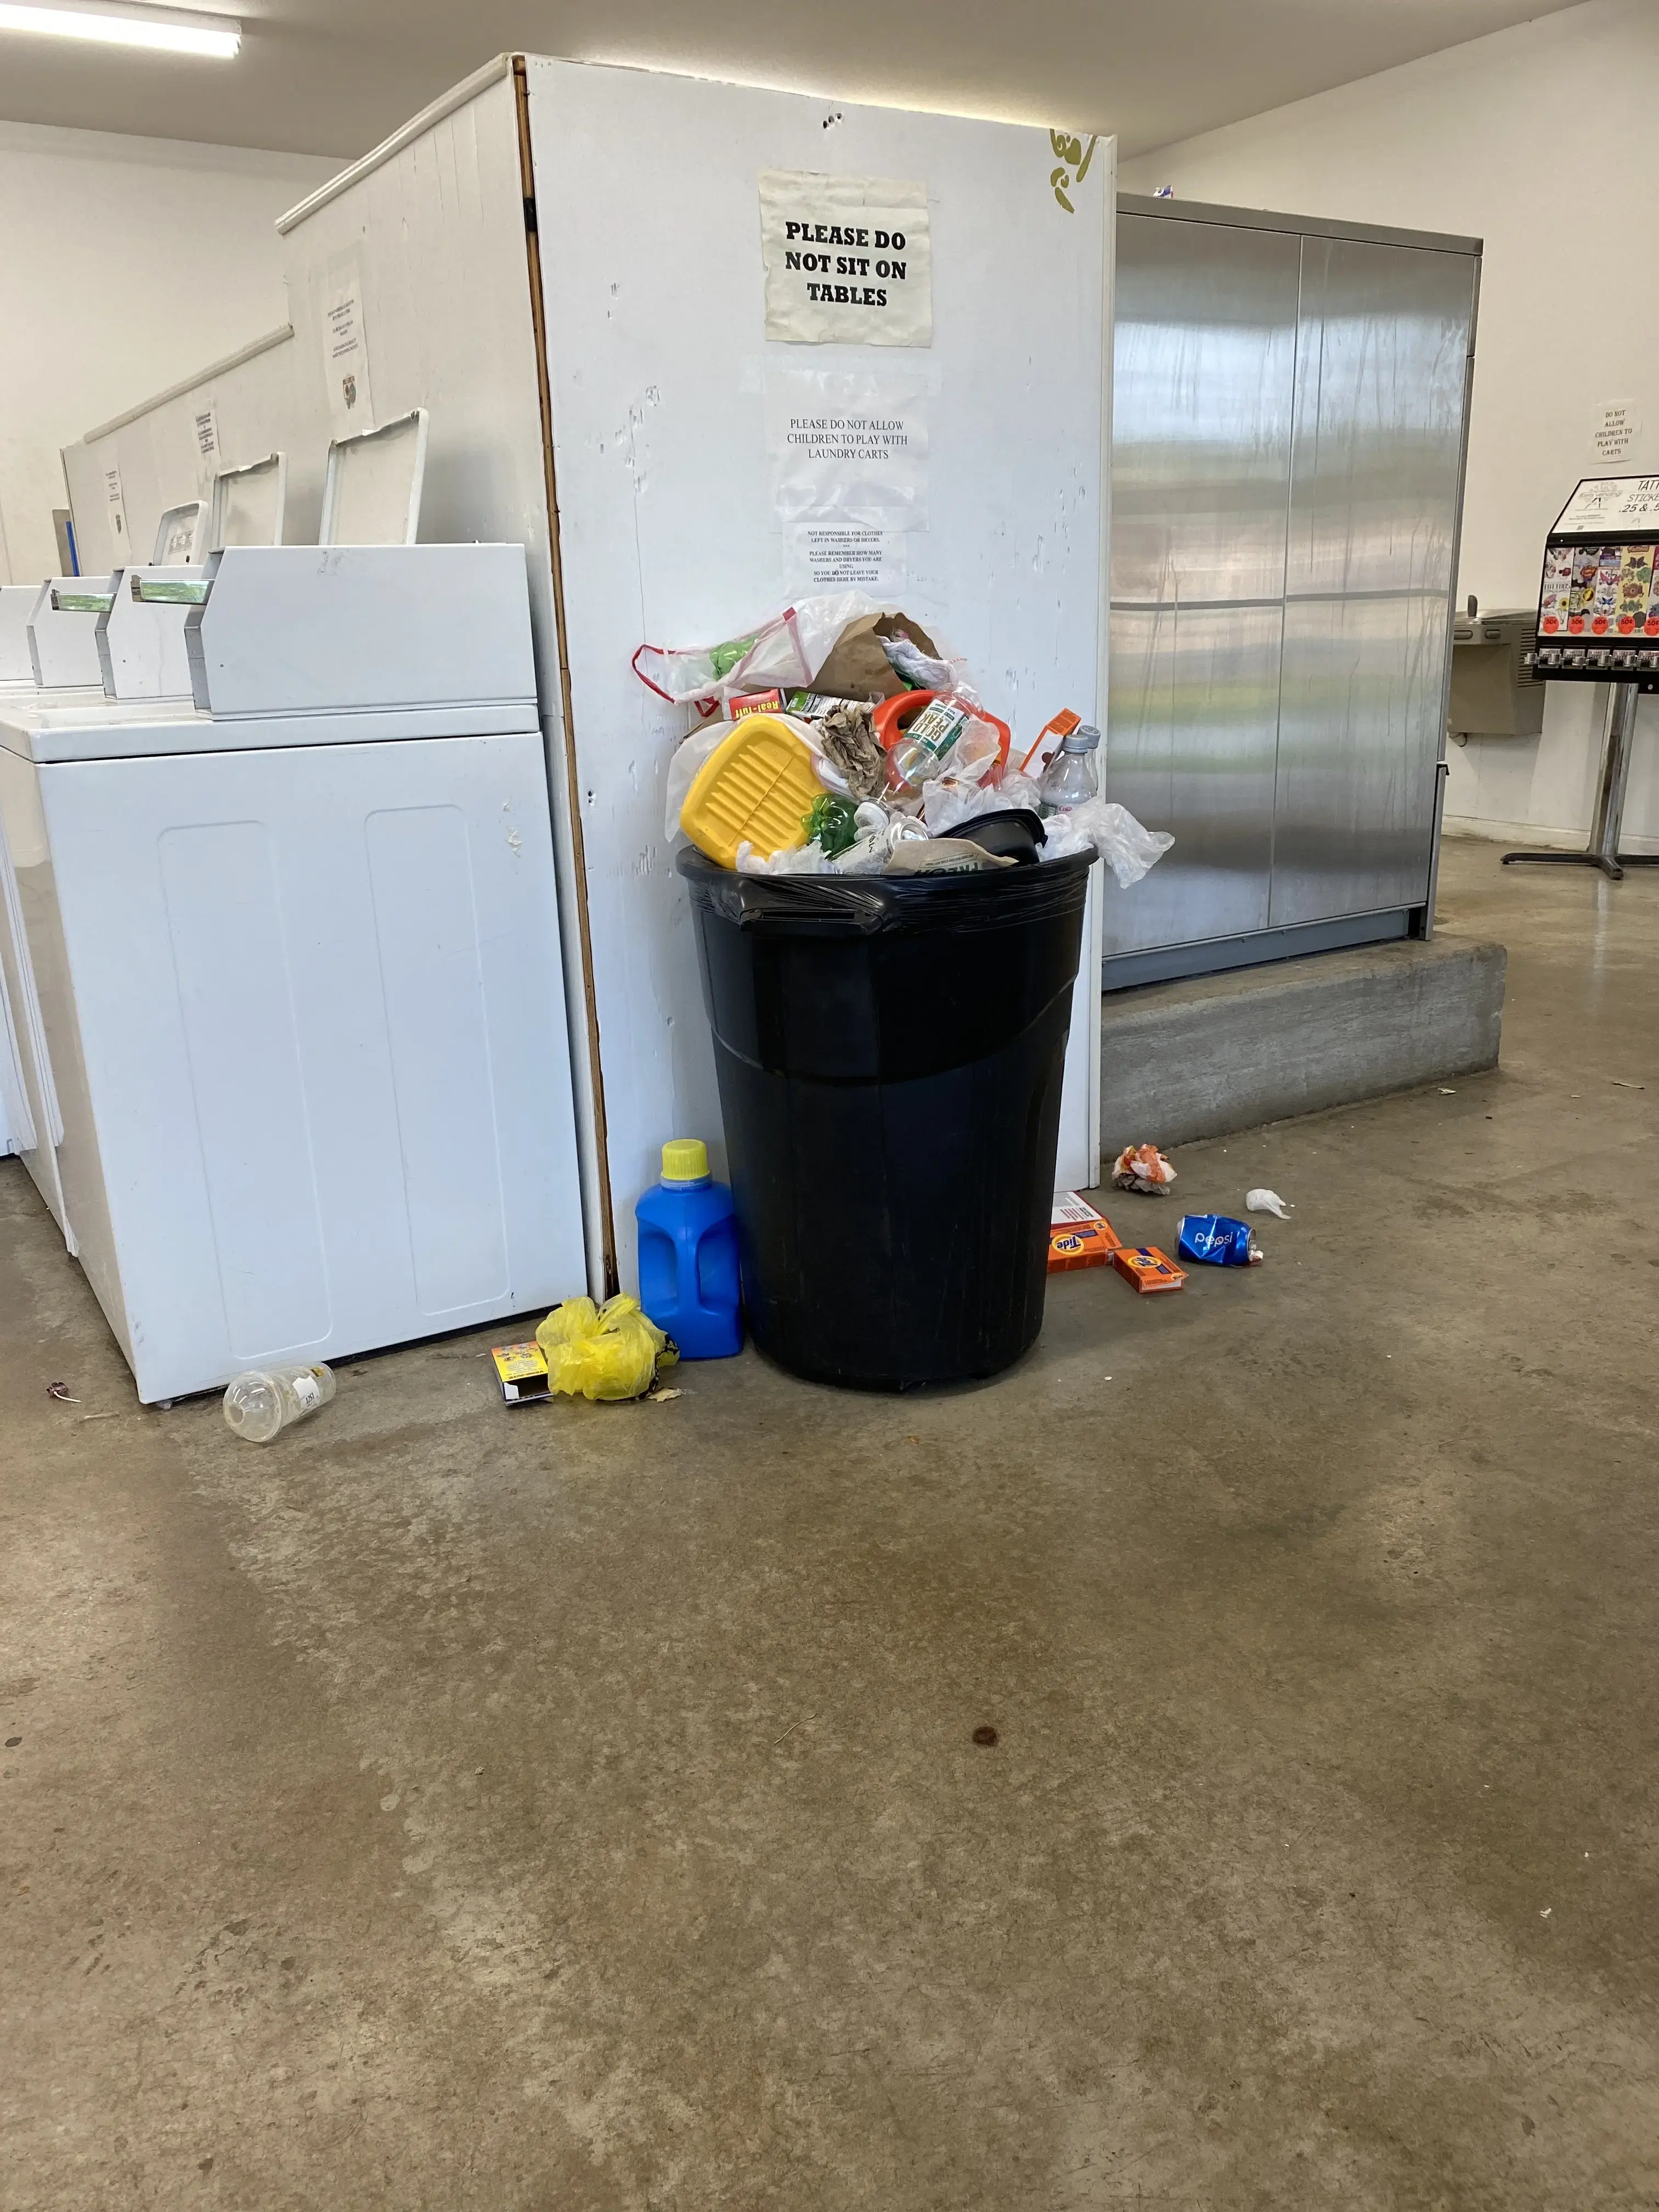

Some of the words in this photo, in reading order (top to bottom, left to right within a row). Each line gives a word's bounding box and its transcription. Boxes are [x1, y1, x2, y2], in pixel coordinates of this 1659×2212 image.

[785, 221, 869, 247] PLEASE
[874, 230, 906, 250] DO
[785, 251, 831, 273] NOT
[837, 256, 870, 276] SIT
[876, 260, 907, 280] ON
[807, 283, 887, 307] TABLES
[790, 419, 828, 429] PLEASE
[830, 419, 845, 430] DO
[847, 420, 867, 430] NOT
[868, 420, 904, 431] ALLOW
[1604, 418, 1626, 428] ALLOW
[787, 433, 839, 444] CHILDREN
[841, 434, 854, 444] TO
[856, 435, 880, 445] PLAY
[882, 435, 908, 445] WITH
[1595, 429, 1623, 438] CHILDREN
[1597, 438, 1613, 448] PLAY
[808, 448, 856, 459] LAUNDRY
[858, 449, 889, 459] CARTS
[1618, 504, 1639, 513] .25
[1639, 503, 1648, 512] &
[919, 713, 950, 733] PEAK
[912, 723, 942, 742] GOLD
[1057, 1235, 1081, 1250] Tide
